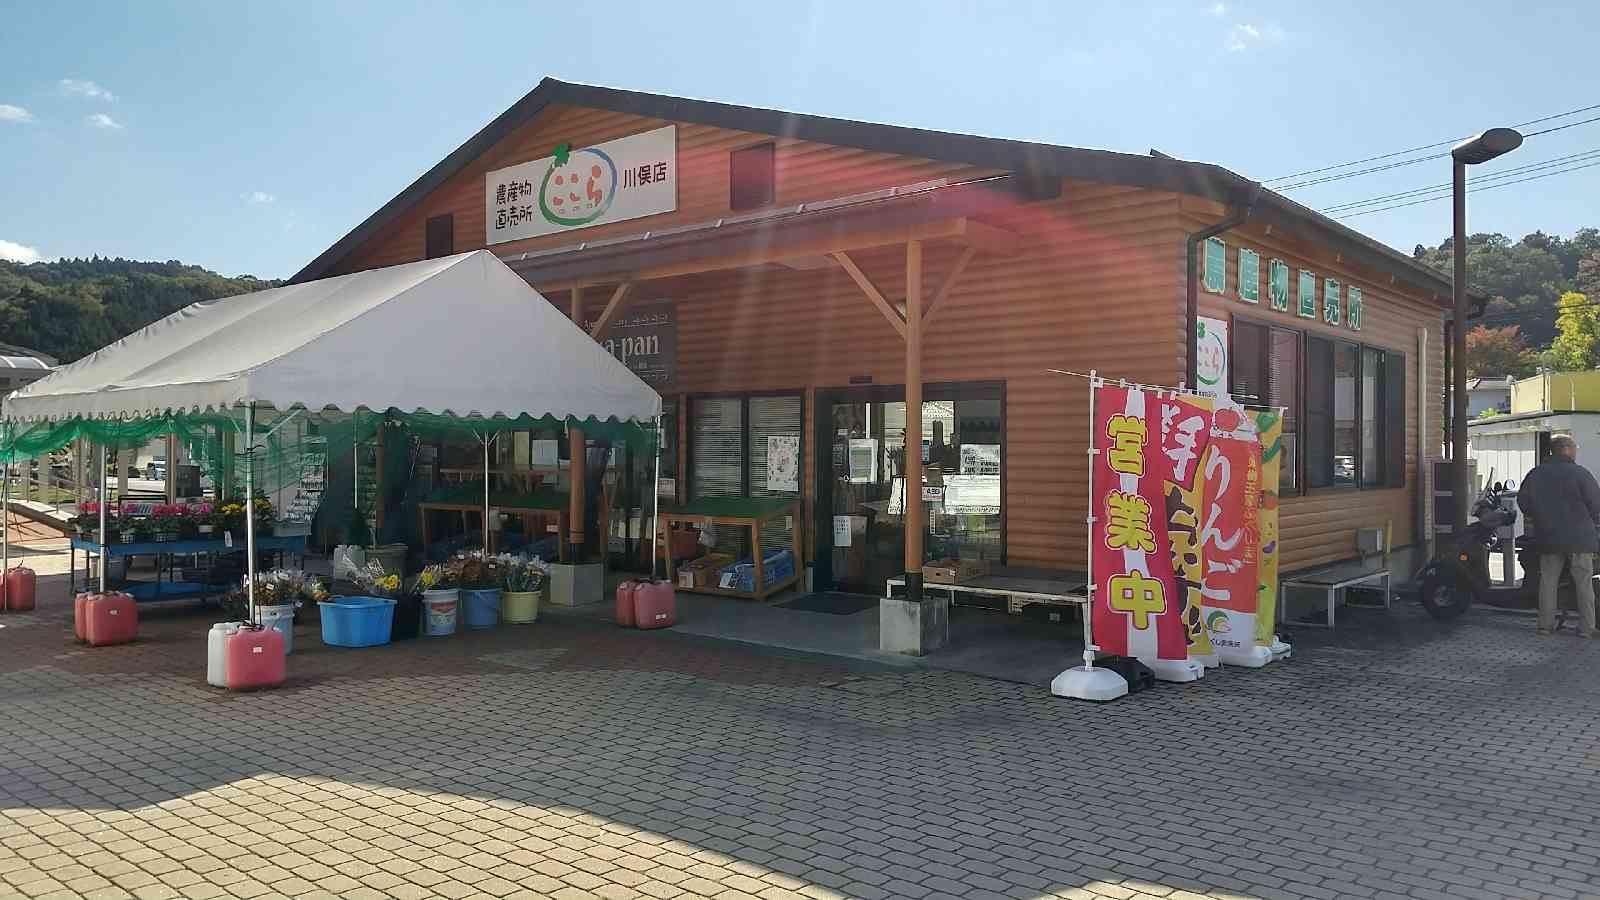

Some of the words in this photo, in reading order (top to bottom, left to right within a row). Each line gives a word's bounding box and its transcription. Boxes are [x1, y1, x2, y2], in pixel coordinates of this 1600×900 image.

[624, 161, 667, 189] 川俣店
[496, 179, 532, 205] 農産物
[495, 205, 533, 230] 直売所
[1105, 412, 1168, 631] 営業中
[1200, 442, 1244, 602] りんご
